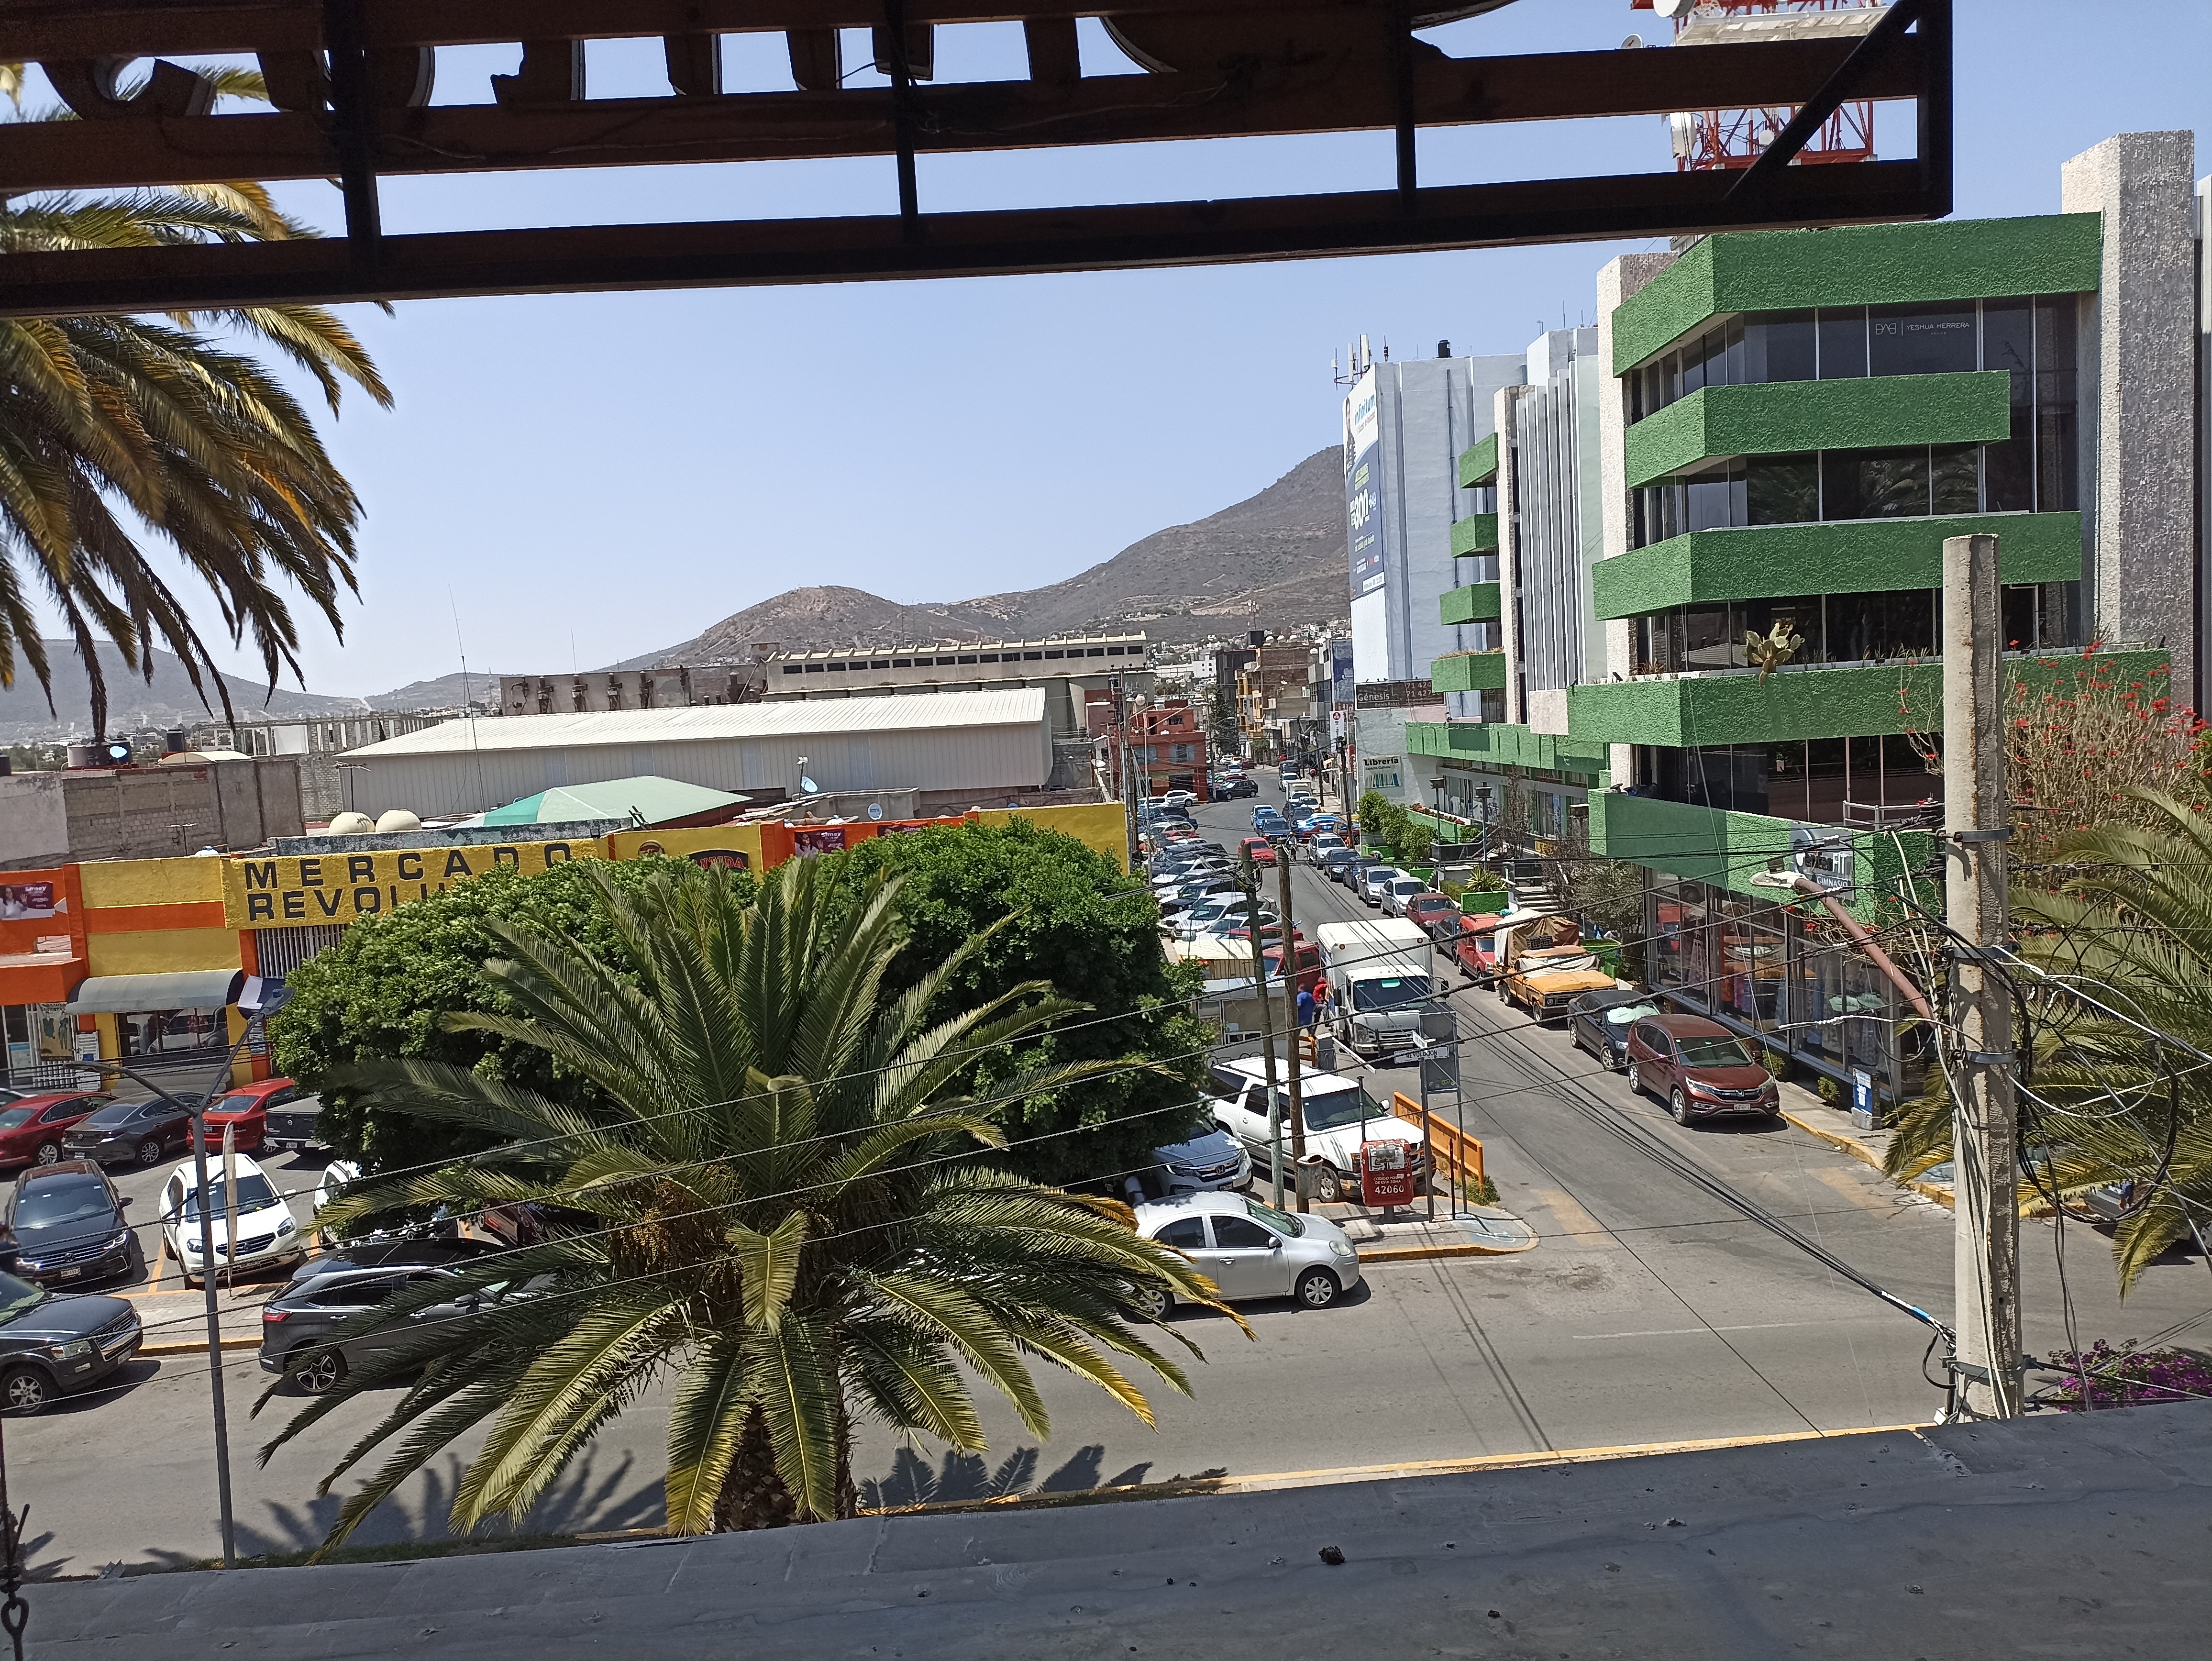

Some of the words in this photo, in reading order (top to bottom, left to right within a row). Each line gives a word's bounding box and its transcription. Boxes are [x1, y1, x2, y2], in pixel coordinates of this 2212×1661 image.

[1354, 394, 1375, 426] infinitum
[1357, 691, 1390, 701] Génesis
[244, 843, 571, 890] MERCADO
[1816, 875, 1848, 888] GIMNASIO
[1375, 1185, 1405, 1194] 42060
